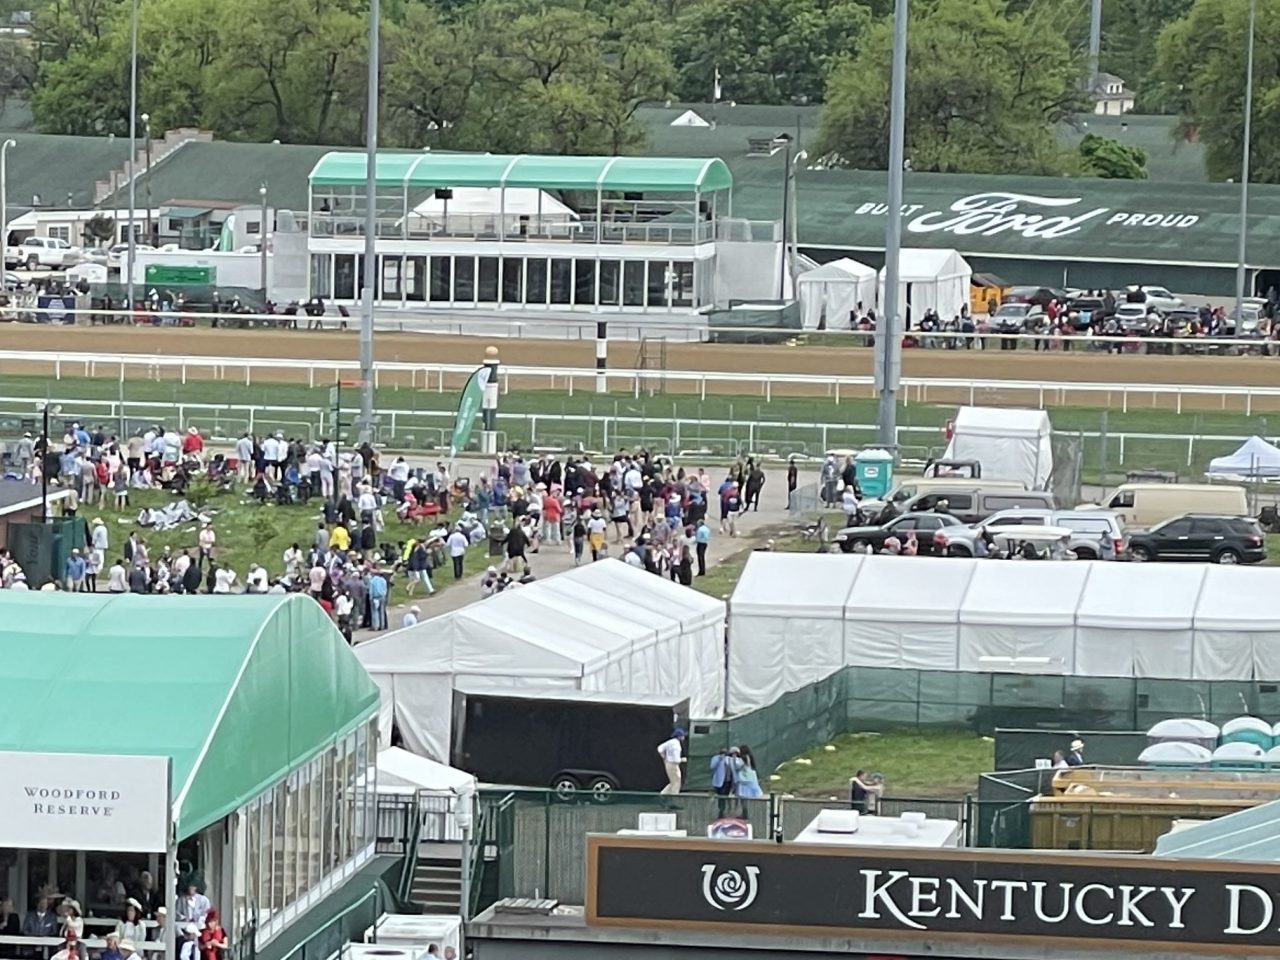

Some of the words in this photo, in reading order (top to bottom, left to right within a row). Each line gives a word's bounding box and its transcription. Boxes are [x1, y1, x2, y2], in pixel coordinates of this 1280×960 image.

[907, 192, 1110, 238] Ford
[1106, 213, 1201, 228] PROUD
[24, 786, 121, 800] WOODFORD
[34, 803, 114, 816] RESERVE
[858, 869, 1196, 929] KENTUCKY
[1223, 884, 1280, 934] D
